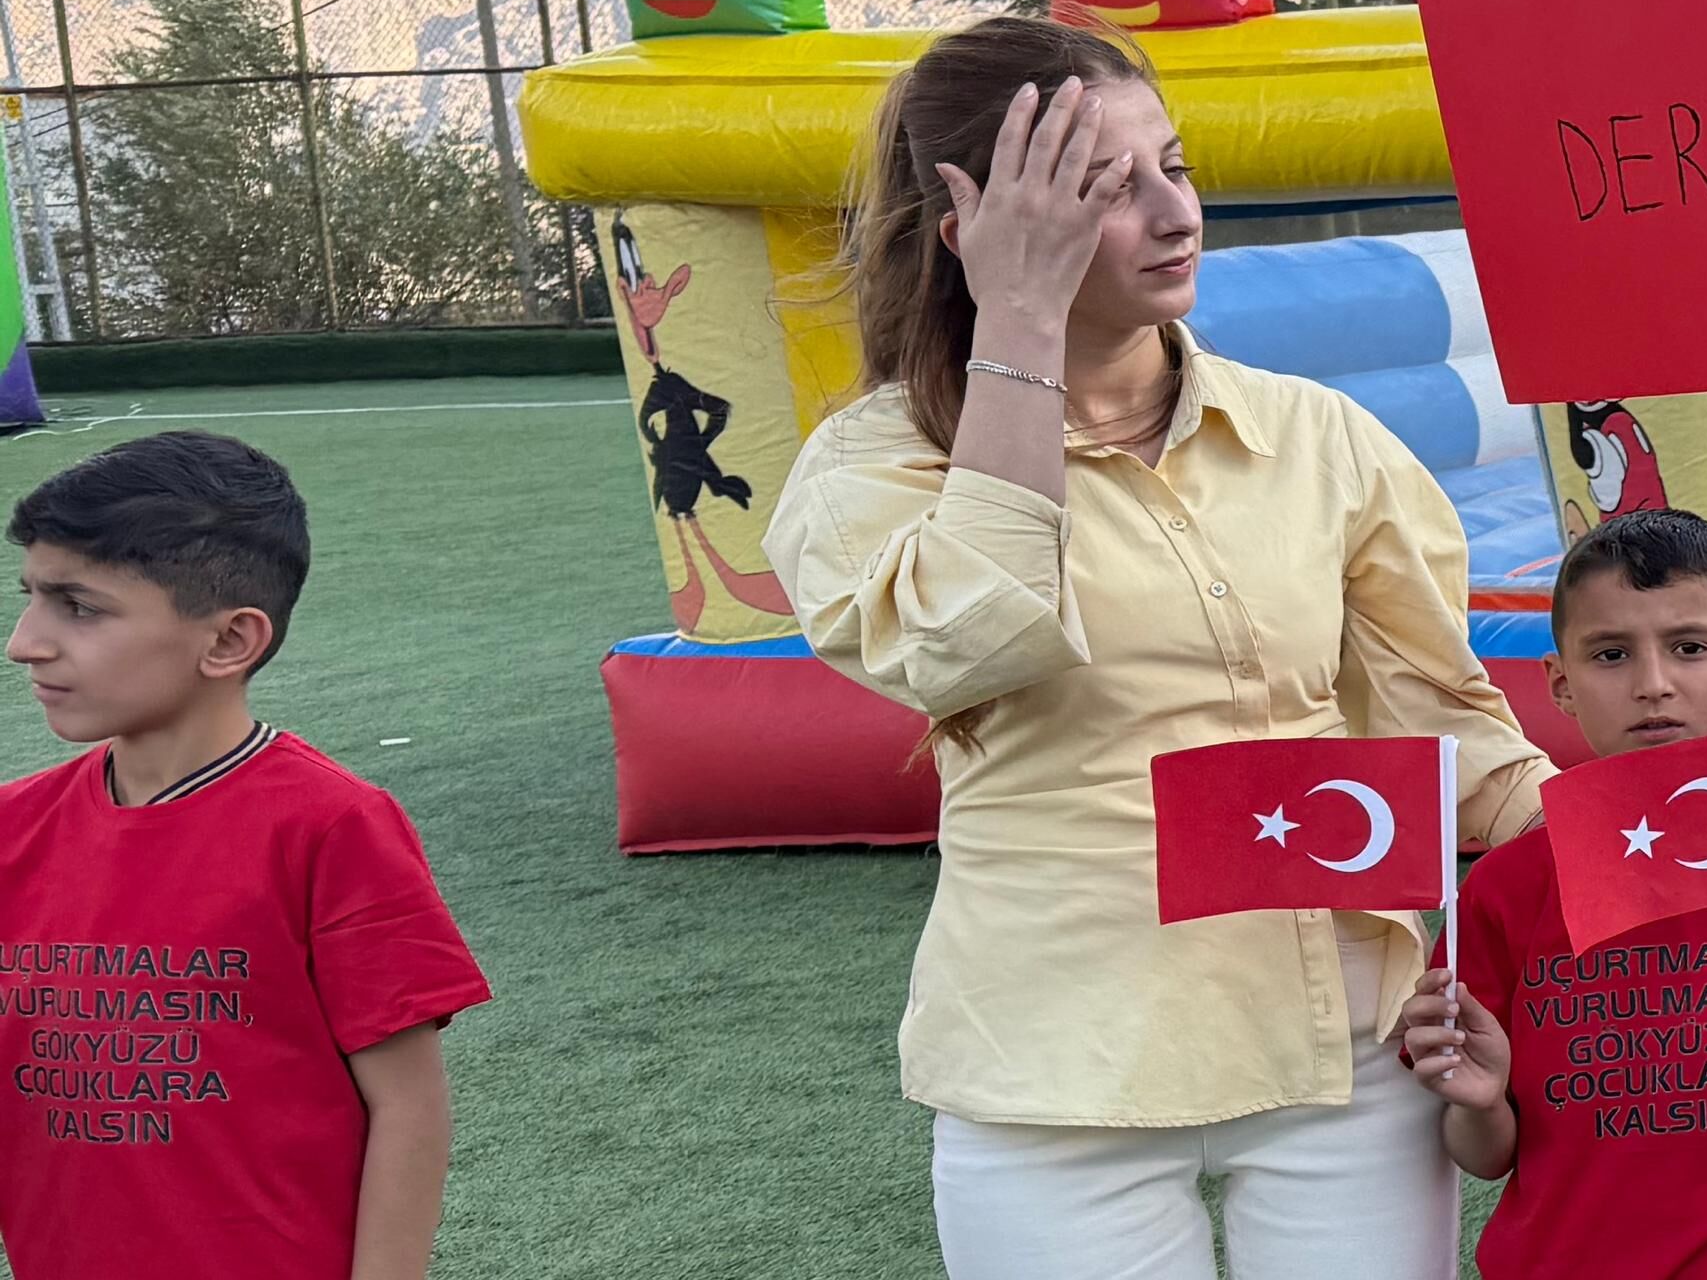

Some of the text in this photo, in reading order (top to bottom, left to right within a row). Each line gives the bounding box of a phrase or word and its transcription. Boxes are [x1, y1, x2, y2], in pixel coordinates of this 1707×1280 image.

[0, 943, 249, 981] UÇURTMALAR
[31, 1026, 201, 1065] GÖKYÜZÜ
[14, 1064, 231, 1102] ÇOCUKLARA
[47, 1109, 172, 1144] KALSIN
